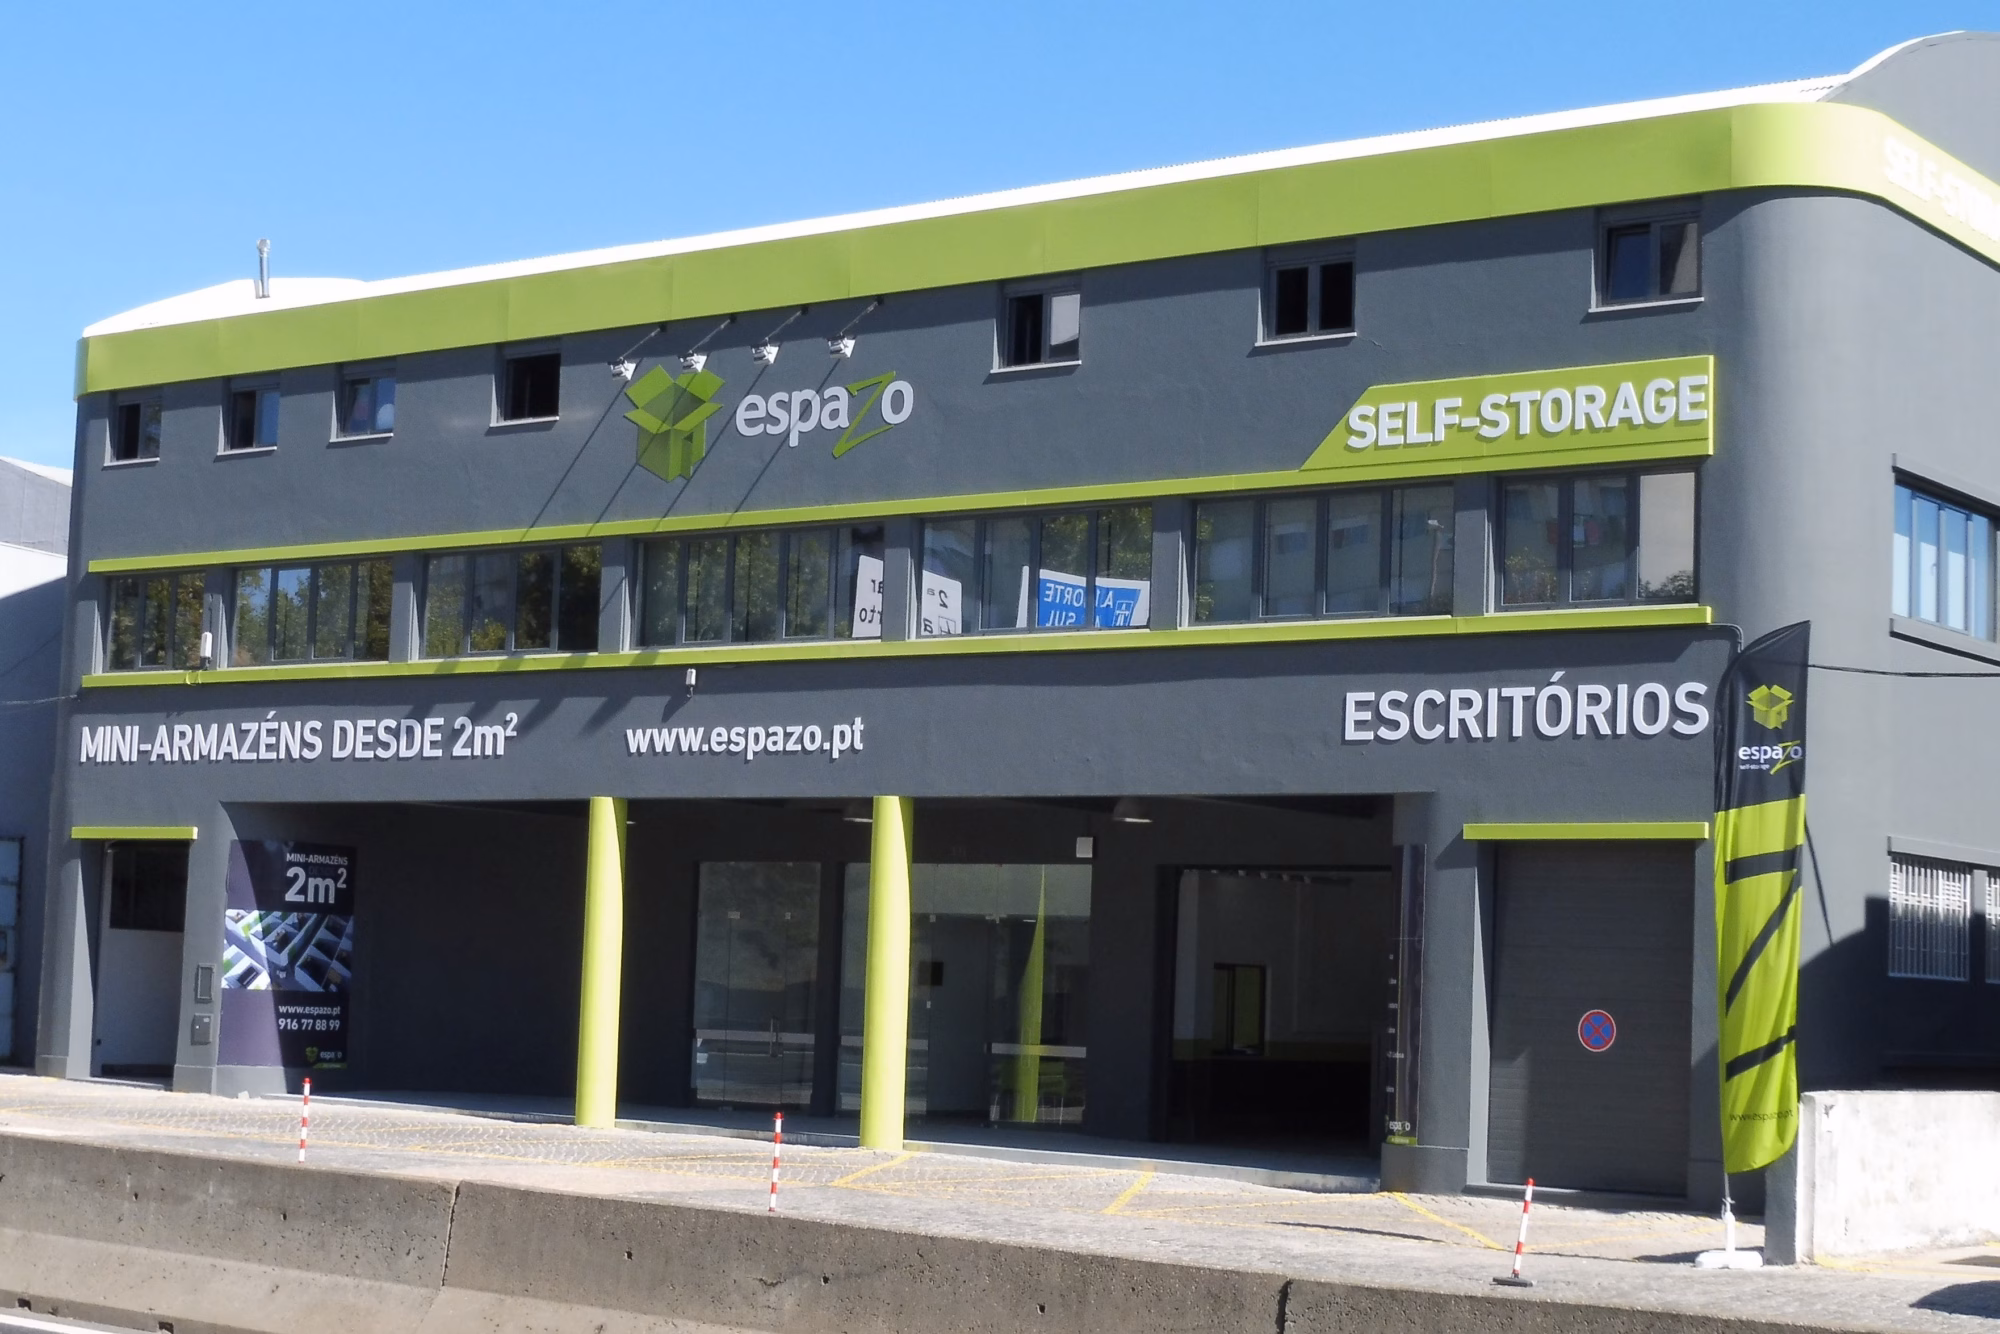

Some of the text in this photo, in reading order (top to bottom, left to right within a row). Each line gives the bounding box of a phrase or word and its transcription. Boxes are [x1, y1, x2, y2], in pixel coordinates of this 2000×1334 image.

[1347, 375, 1708, 448] SELF-STORAGE
[1345, 671, 1709, 740] ESCRITÓRIOS
[80, 711, 322, 762] MINI-ARMAZÉNS
[332, 718, 444, 759] DESDE
[626, 717, 864, 760] www.espazo.pt
[286, 853, 348, 866] MINI-ARMAZÉNS
[279, 1005, 341, 1016] www.espazo.pt
[279, 1018, 340, 1031] 916 77 88 99
